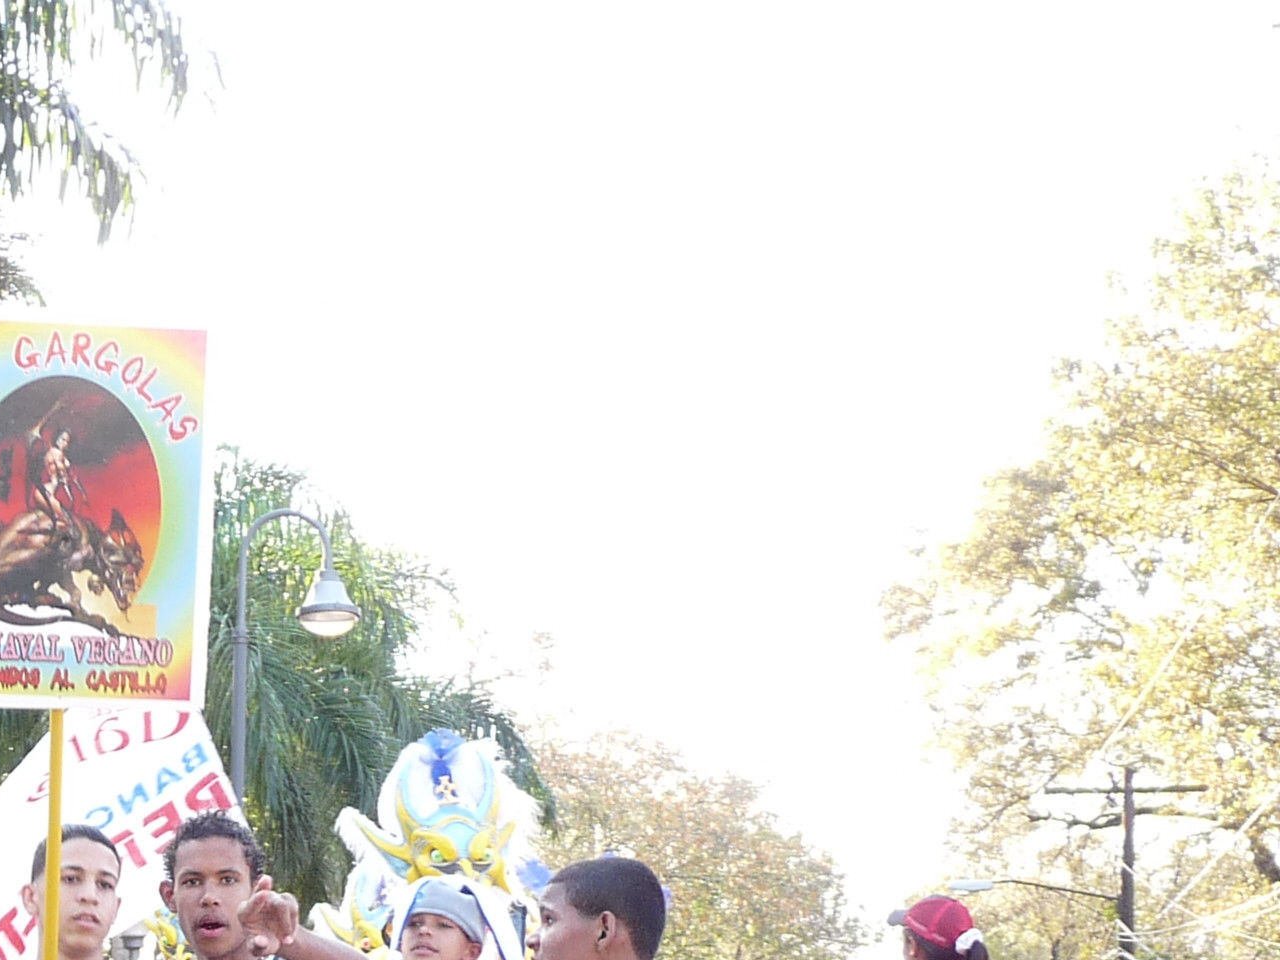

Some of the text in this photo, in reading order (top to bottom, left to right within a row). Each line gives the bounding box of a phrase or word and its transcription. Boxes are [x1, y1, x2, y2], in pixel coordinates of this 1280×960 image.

[14, 331, 199, 441] GARGOLAS
[71, 636, 174, 667] VEGANO
[50, 668, 75, 691] AL
[86, 669, 168, 694] CASTILLO
